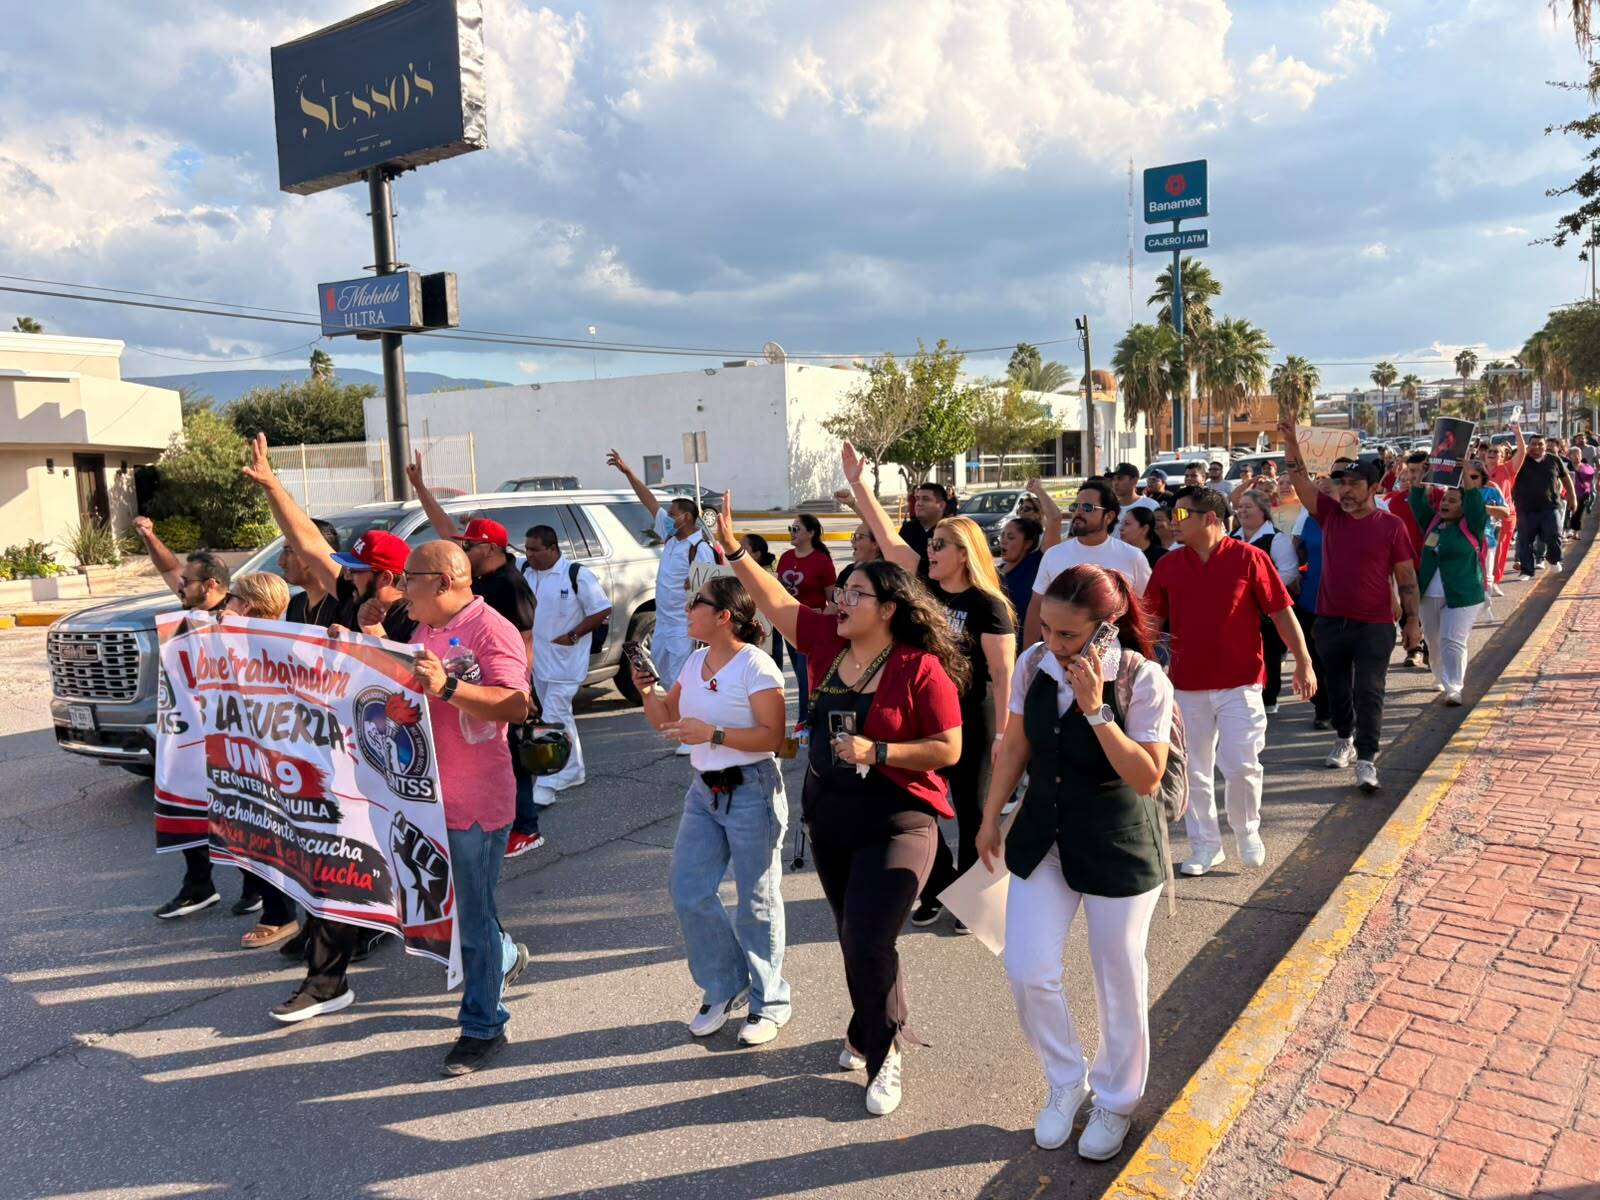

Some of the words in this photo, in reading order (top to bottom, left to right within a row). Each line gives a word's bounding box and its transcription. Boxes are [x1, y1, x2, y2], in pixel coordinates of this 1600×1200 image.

[1149, 197, 1202, 213] Banamex
[1148, 236, 1181, 247] CAJERO
[1187, 233, 1205, 243] ATM
[337, 283, 400, 312] Michelob
[344, 309, 385, 328] ULTRA
[61, 643, 97, 659] GMC
[216, 695, 243, 732] LA
[211, 769, 269, 800] FRONTERA
[276, 761, 302, 794] 9
